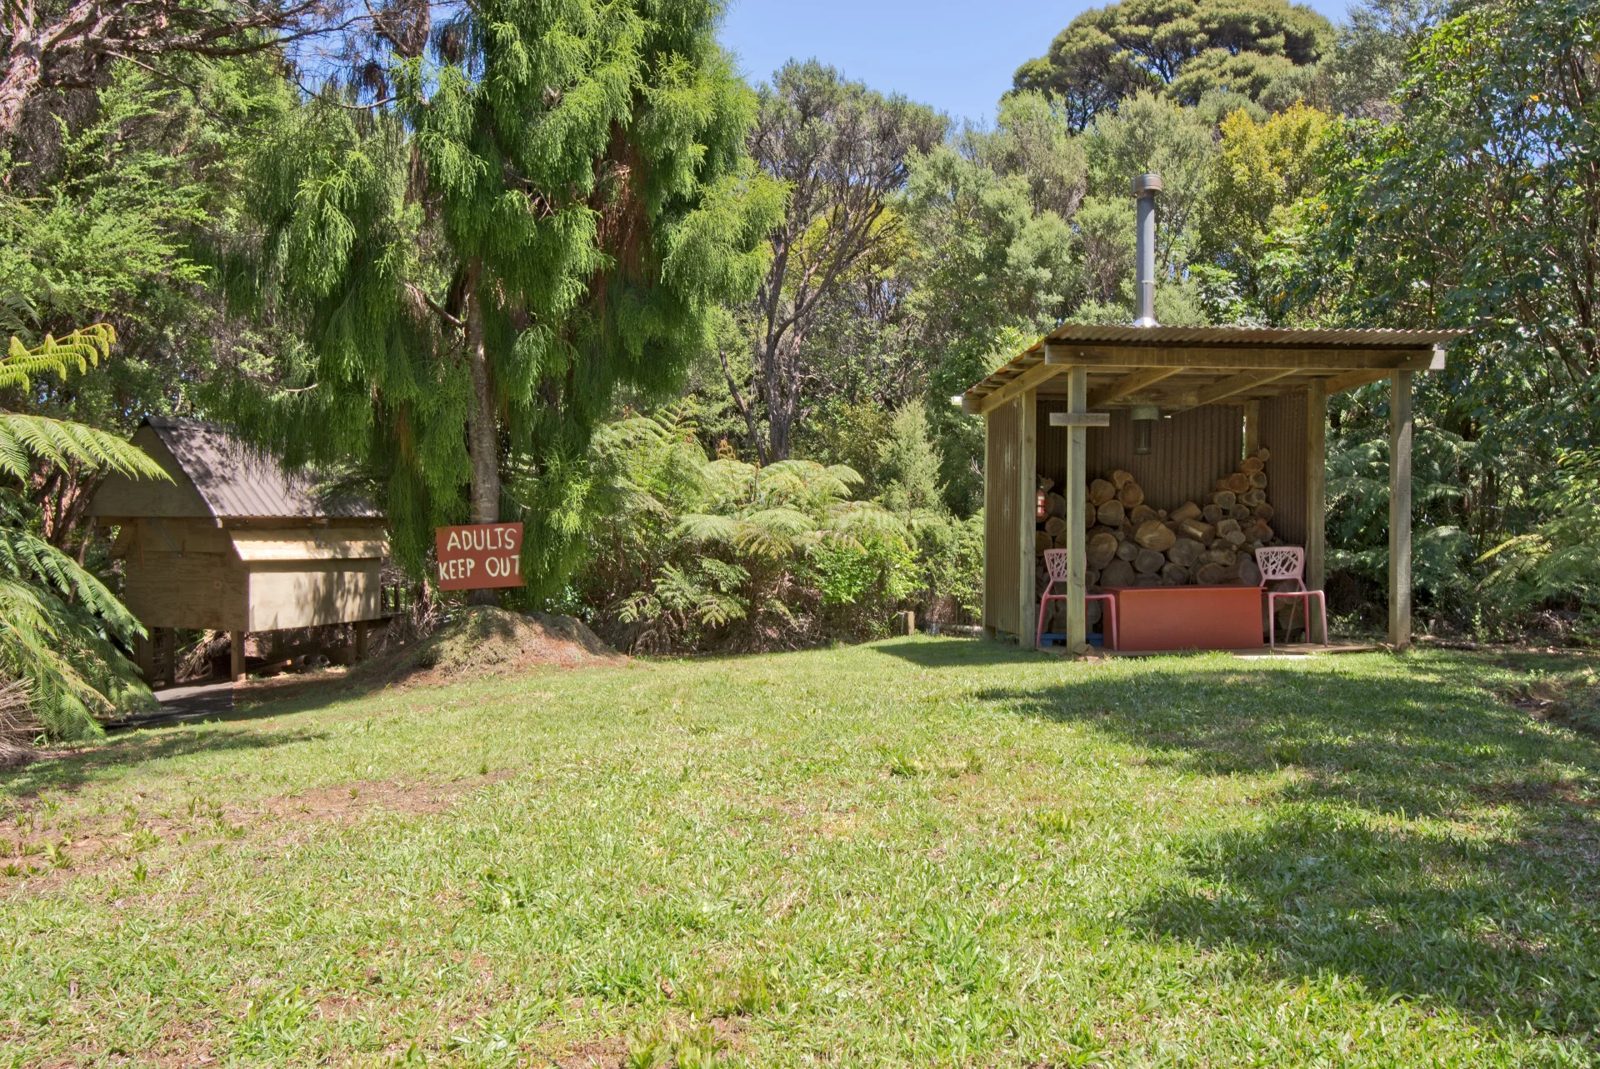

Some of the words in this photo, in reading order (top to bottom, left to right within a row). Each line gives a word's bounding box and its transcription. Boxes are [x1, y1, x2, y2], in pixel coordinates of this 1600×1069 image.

[446, 527, 517, 551] ADULTS
[438, 558, 475, 580] KEEP
[485, 555, 520, 577] OUT
